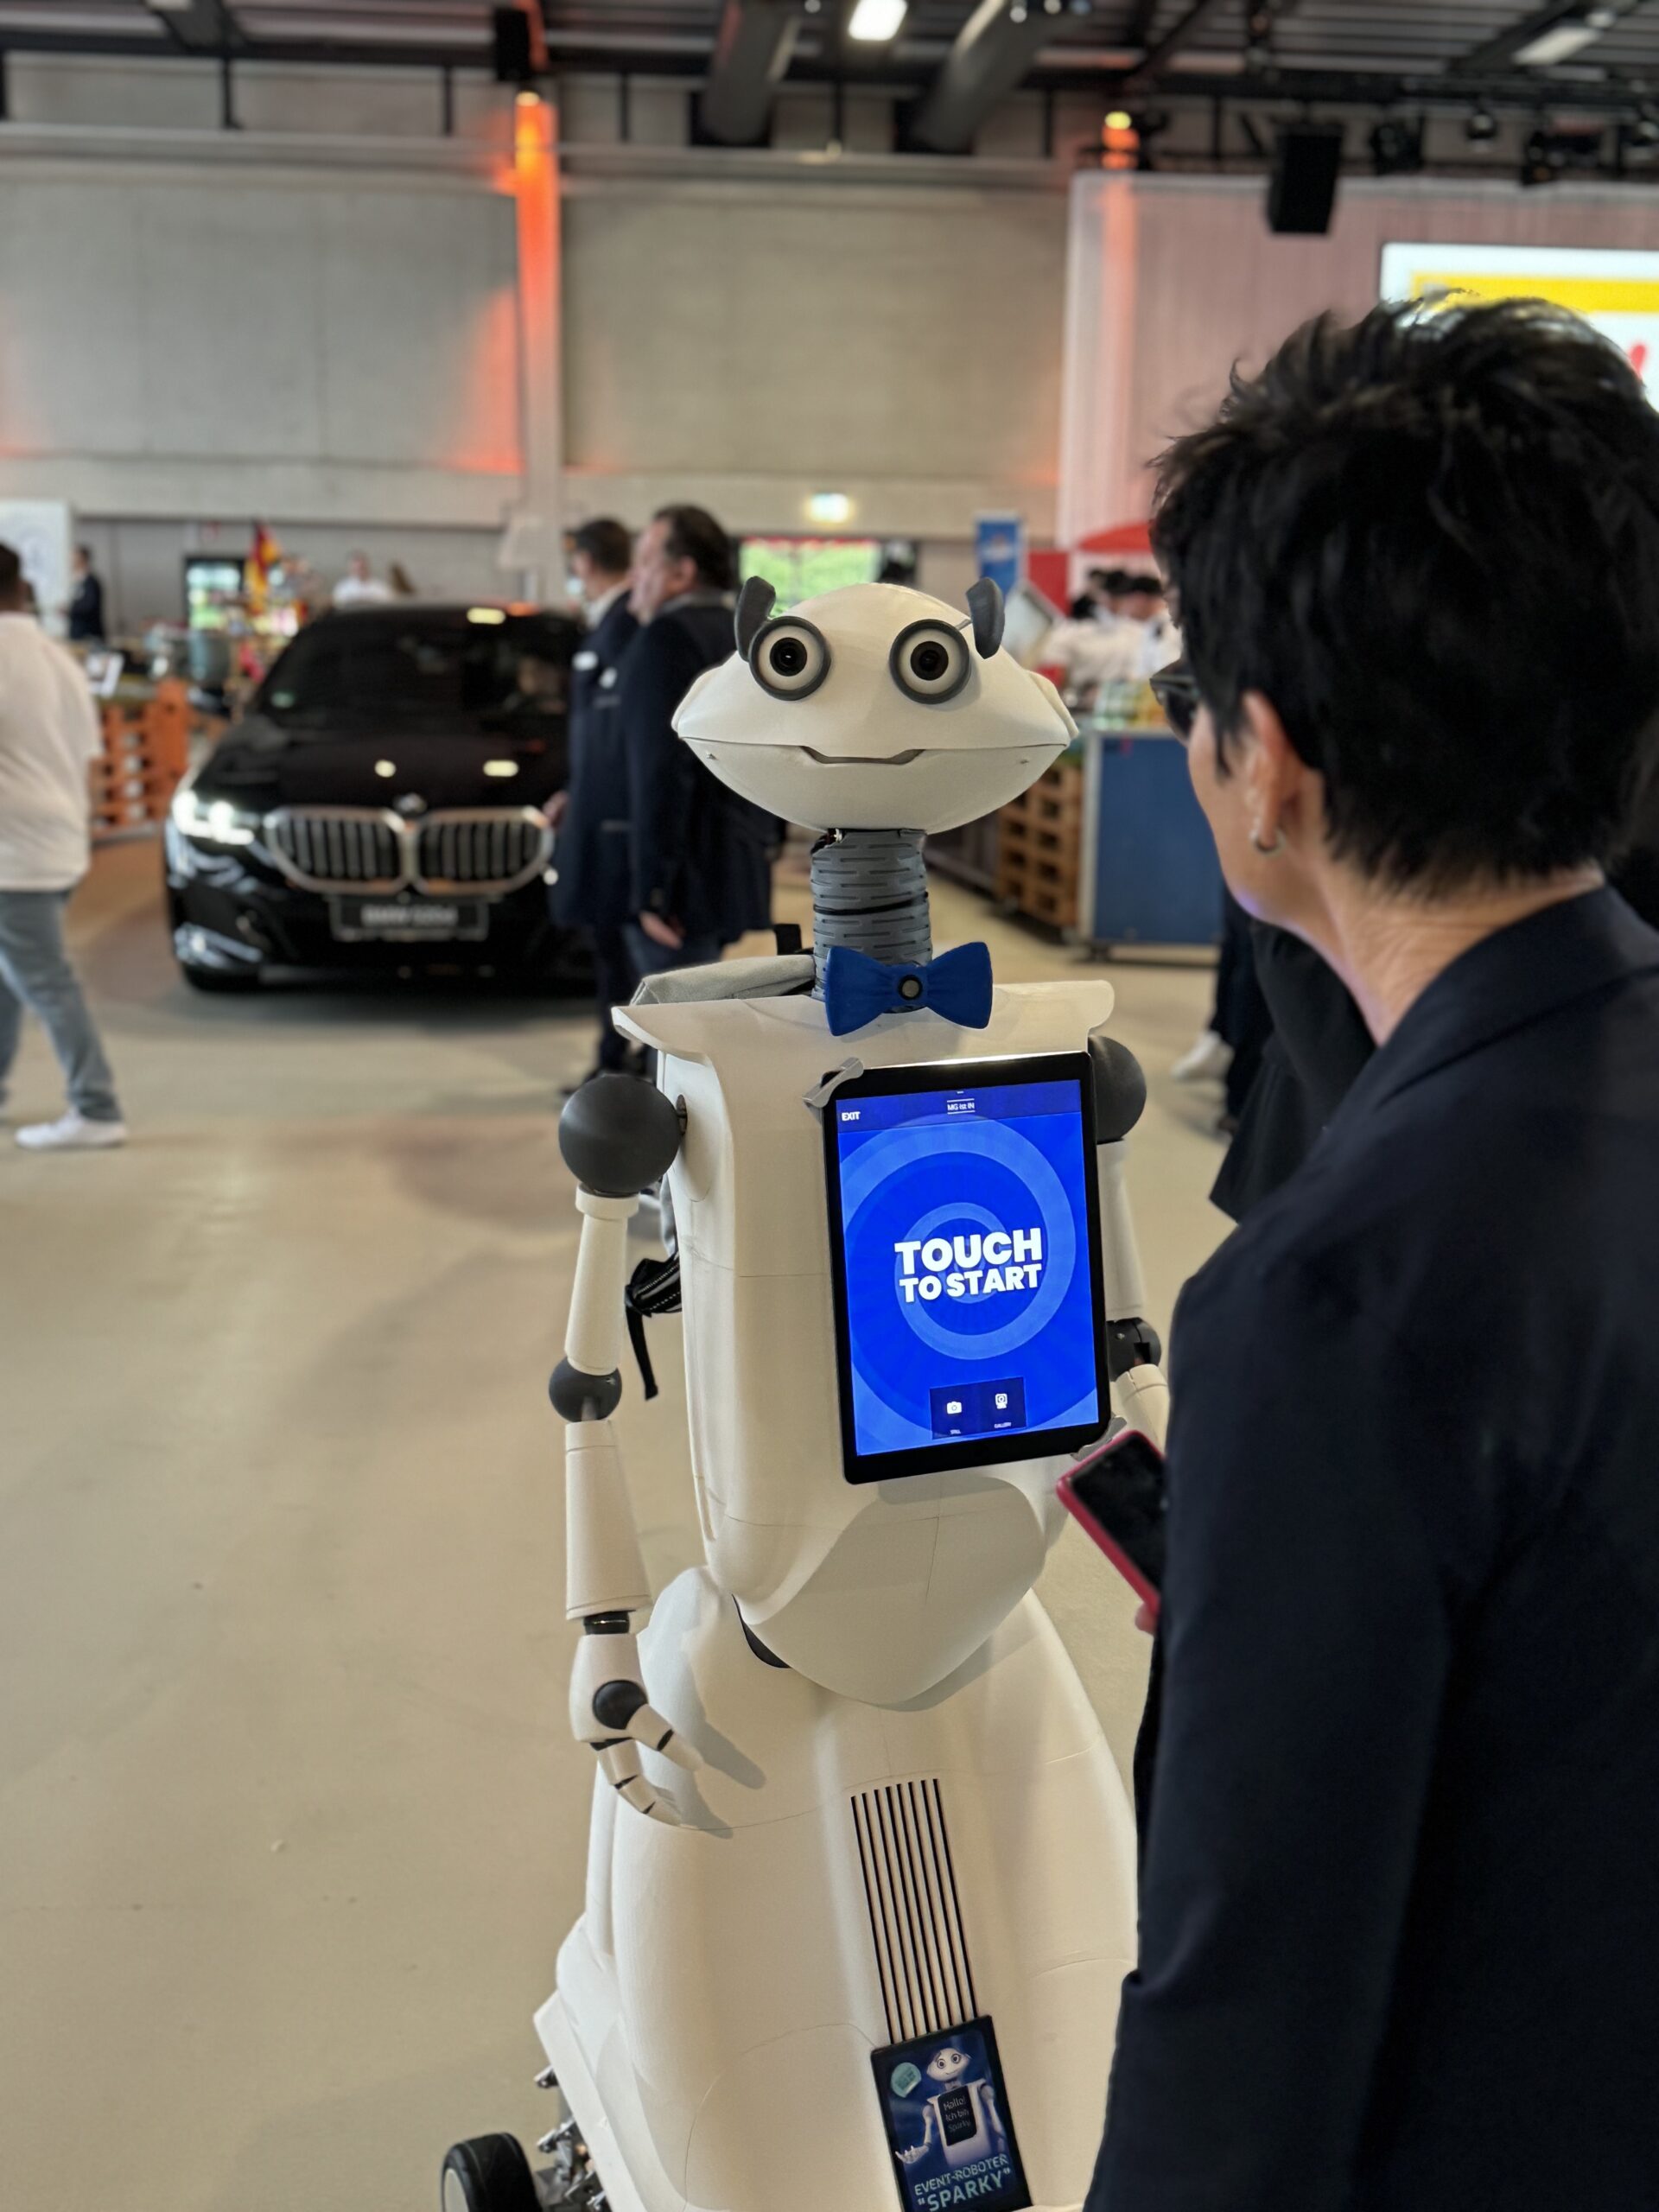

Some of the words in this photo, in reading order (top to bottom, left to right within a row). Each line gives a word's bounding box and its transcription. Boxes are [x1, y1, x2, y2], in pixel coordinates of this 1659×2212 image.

[841, 1111, 861, 1122] EXIT
[894, 1227, 1042, 1275] TOUCH
[899, 1275, 942, 1303] TO
[945, 1263, 1042, 1297] START
[914, 2152, 1009, 2196] EVENT-ROBOTER
